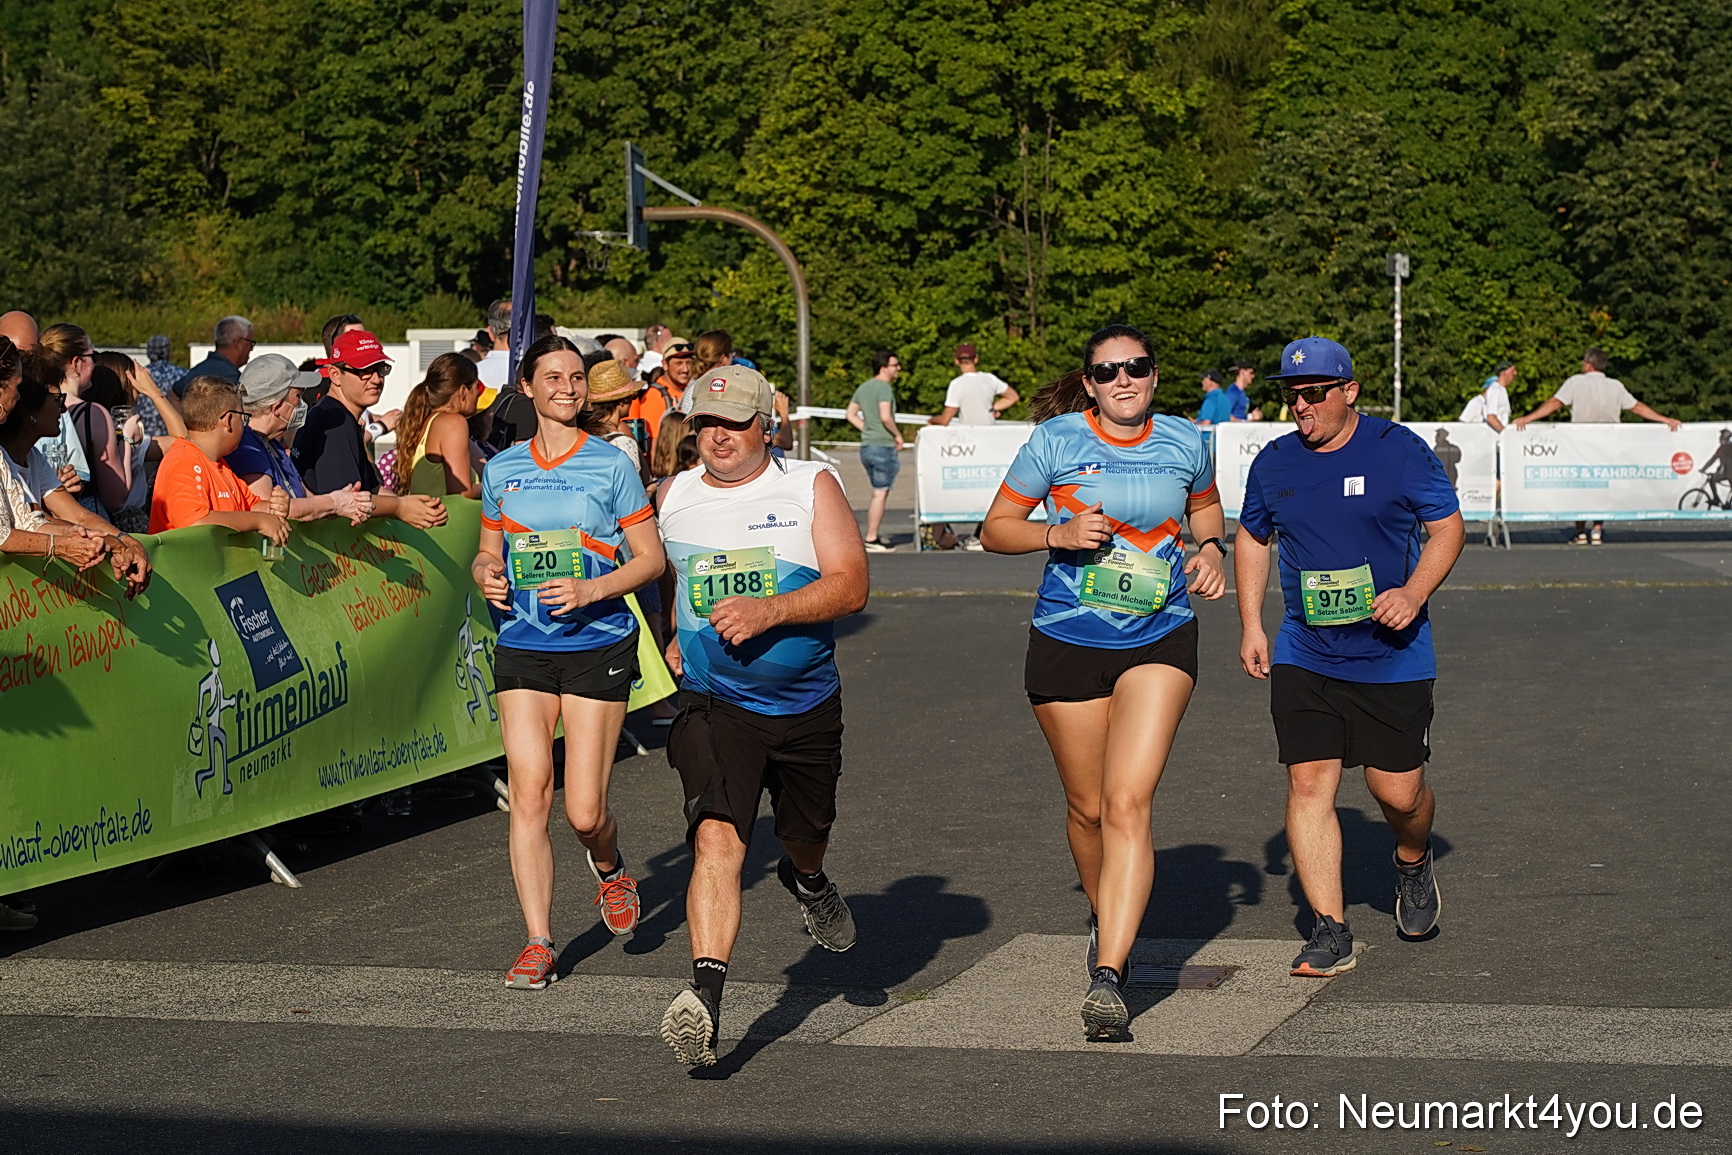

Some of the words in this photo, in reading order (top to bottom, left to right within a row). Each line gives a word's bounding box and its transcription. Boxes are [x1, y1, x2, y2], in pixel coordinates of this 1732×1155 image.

[940, 445, 976, 457] NOW
[1239, 443, 1261, 455] NO
[1523, 444, 1558, 456] NOW
[524, 476, 567, 484] Raiffeisenbank
[943, 467, 997, 480] E-BIKES
[1526, 467, 1577, 479] E-BIKES
[1594, 465, 1672, 479] FAHRRÄDER
[301, 541, 357, 598] Gesunde
[514, 559, 523, 579] RUN
[532, 550, 557, 571] 20
[571, 551, 582, 578] 2022
[546, 570, 574, 579] Ramona
[703, 570, 762, 597] 1188
[763, 572, 774, 596] 022
[1084, 572, 1096, 594] RUN
[1118, 572, 1133, 593] 6
[693, 583, 703, 607] RUN
[1092, 588, 1118, 600] Brandl
[1119, 594, 1153, 607] Michelle
[1152, 582, 1165, 610] 2022
[1305, 596, 1315, 615] RUN
[1318, 587, 1358, 608] 975
[341, 586, 391, 633] laufen
[1340, 606, 1364, 615] Sabine
[239, 609, 271, 634] Fischer
[235, 641, 348, 755] firmenlauf
[239, 737, 292, 785] neumarkt
[318, 723, 448, 789] www.firmenlauf-oberpfalz.de
